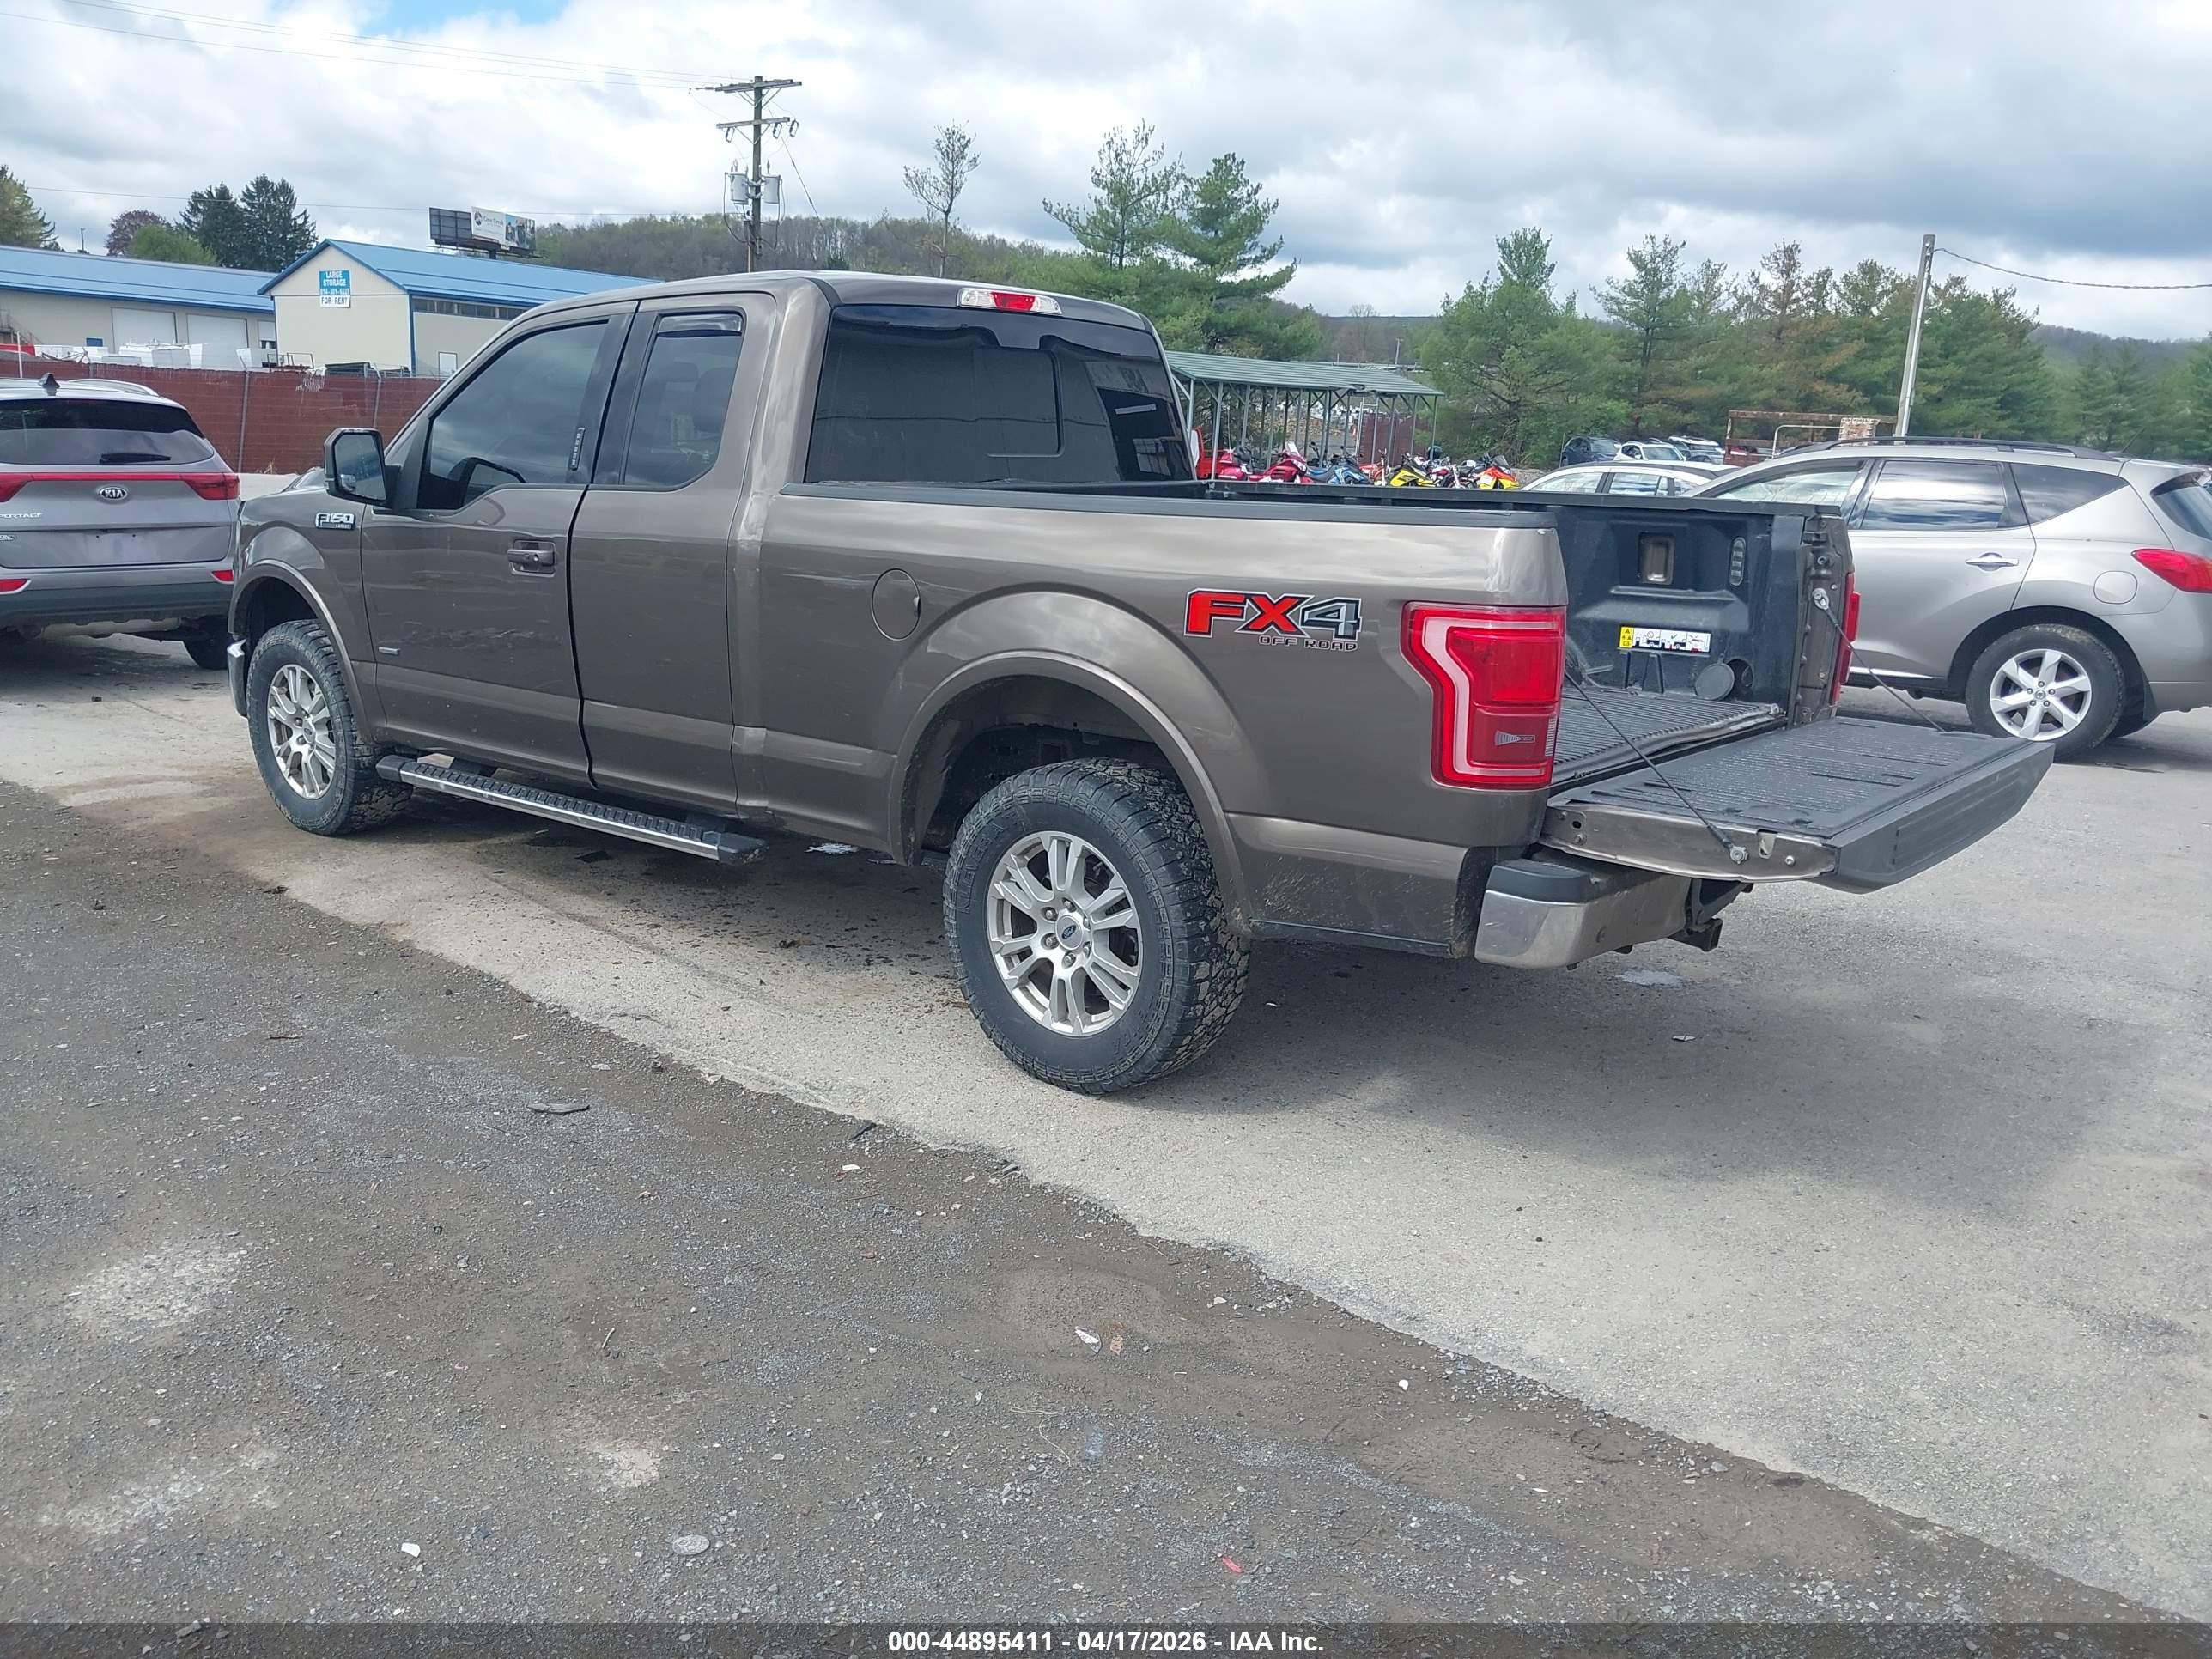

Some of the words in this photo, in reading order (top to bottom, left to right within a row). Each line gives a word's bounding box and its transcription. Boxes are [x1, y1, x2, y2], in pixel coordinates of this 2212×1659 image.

[105, 489, 124, 498] KIA
[1184, 588, 1362, 641] FX4
[1259, 635, 1297, 647] OFF
[1304, 640, 1358, 652] ROAD
